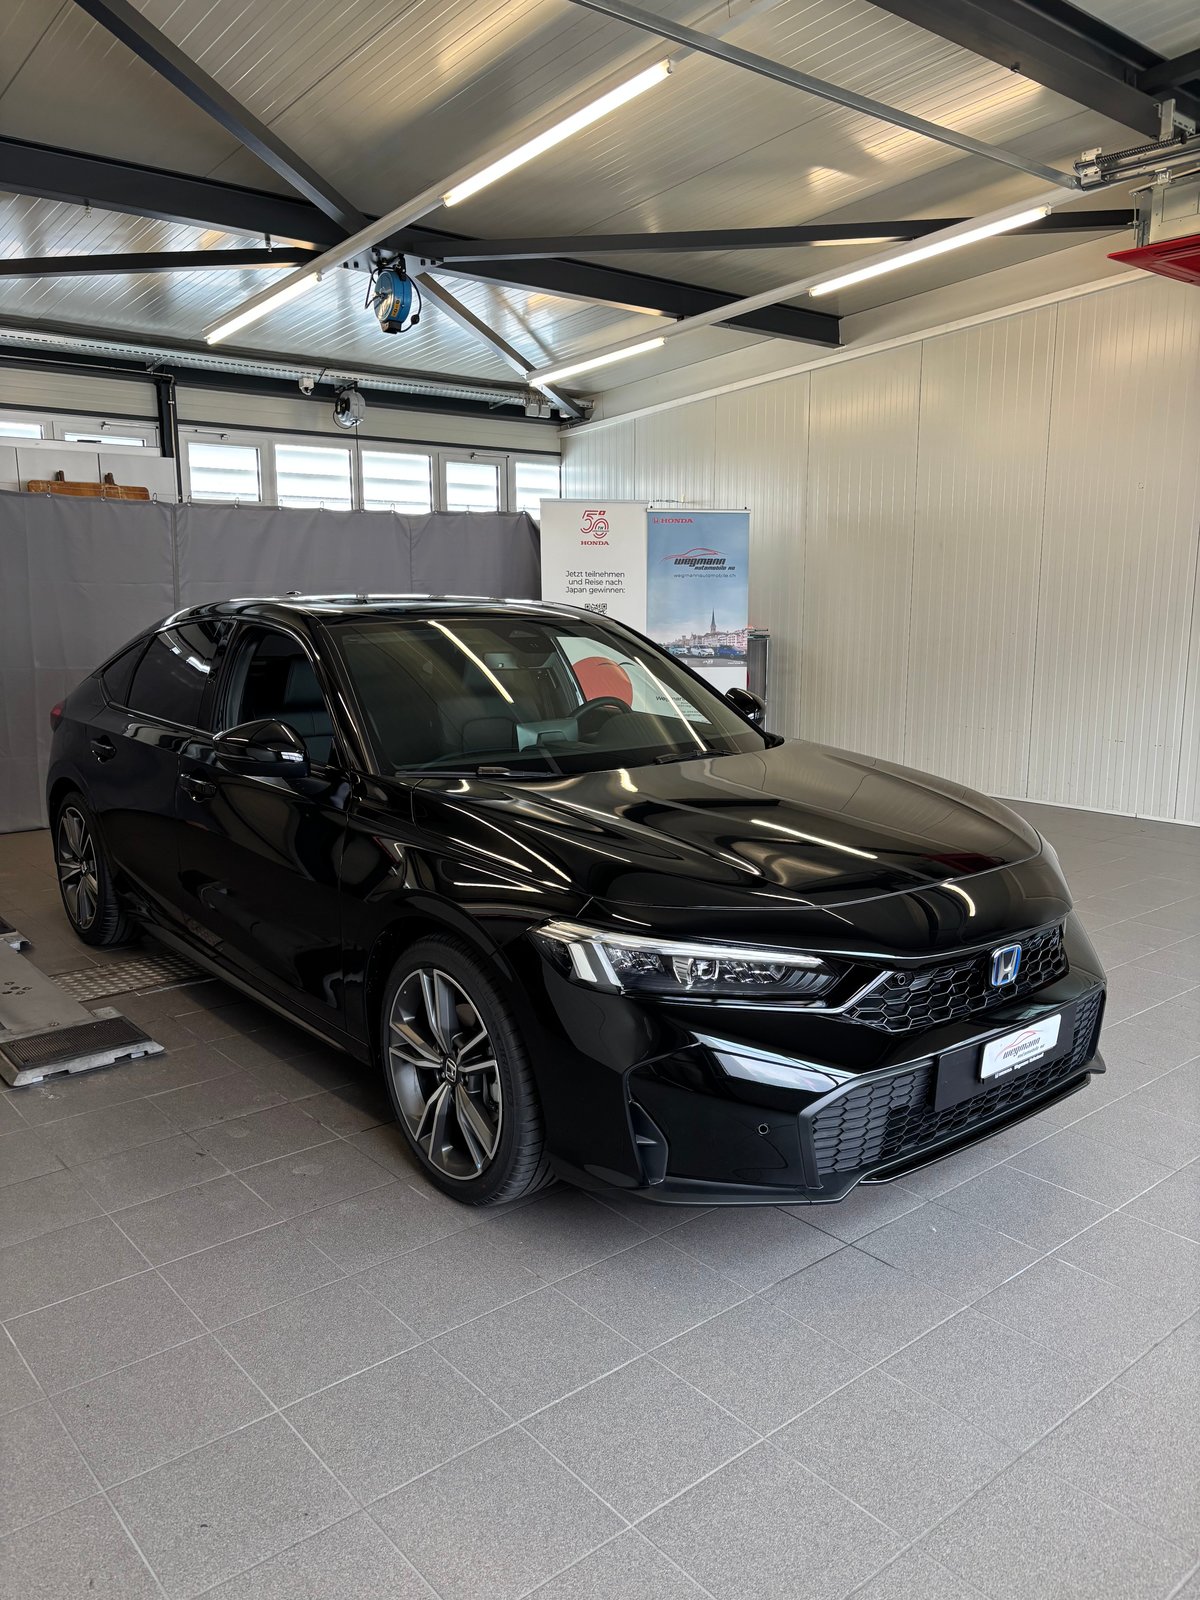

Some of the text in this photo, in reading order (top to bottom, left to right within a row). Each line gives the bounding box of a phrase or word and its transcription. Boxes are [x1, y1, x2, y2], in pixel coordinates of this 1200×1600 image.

[673, 558, 727, 567] wegmann
[565, 570, 626, 578] Jetzt teilnehmen
[568, 578, 623, 586] und Reise nach
[565, 586, 626, 595] Japan gewinnen:
